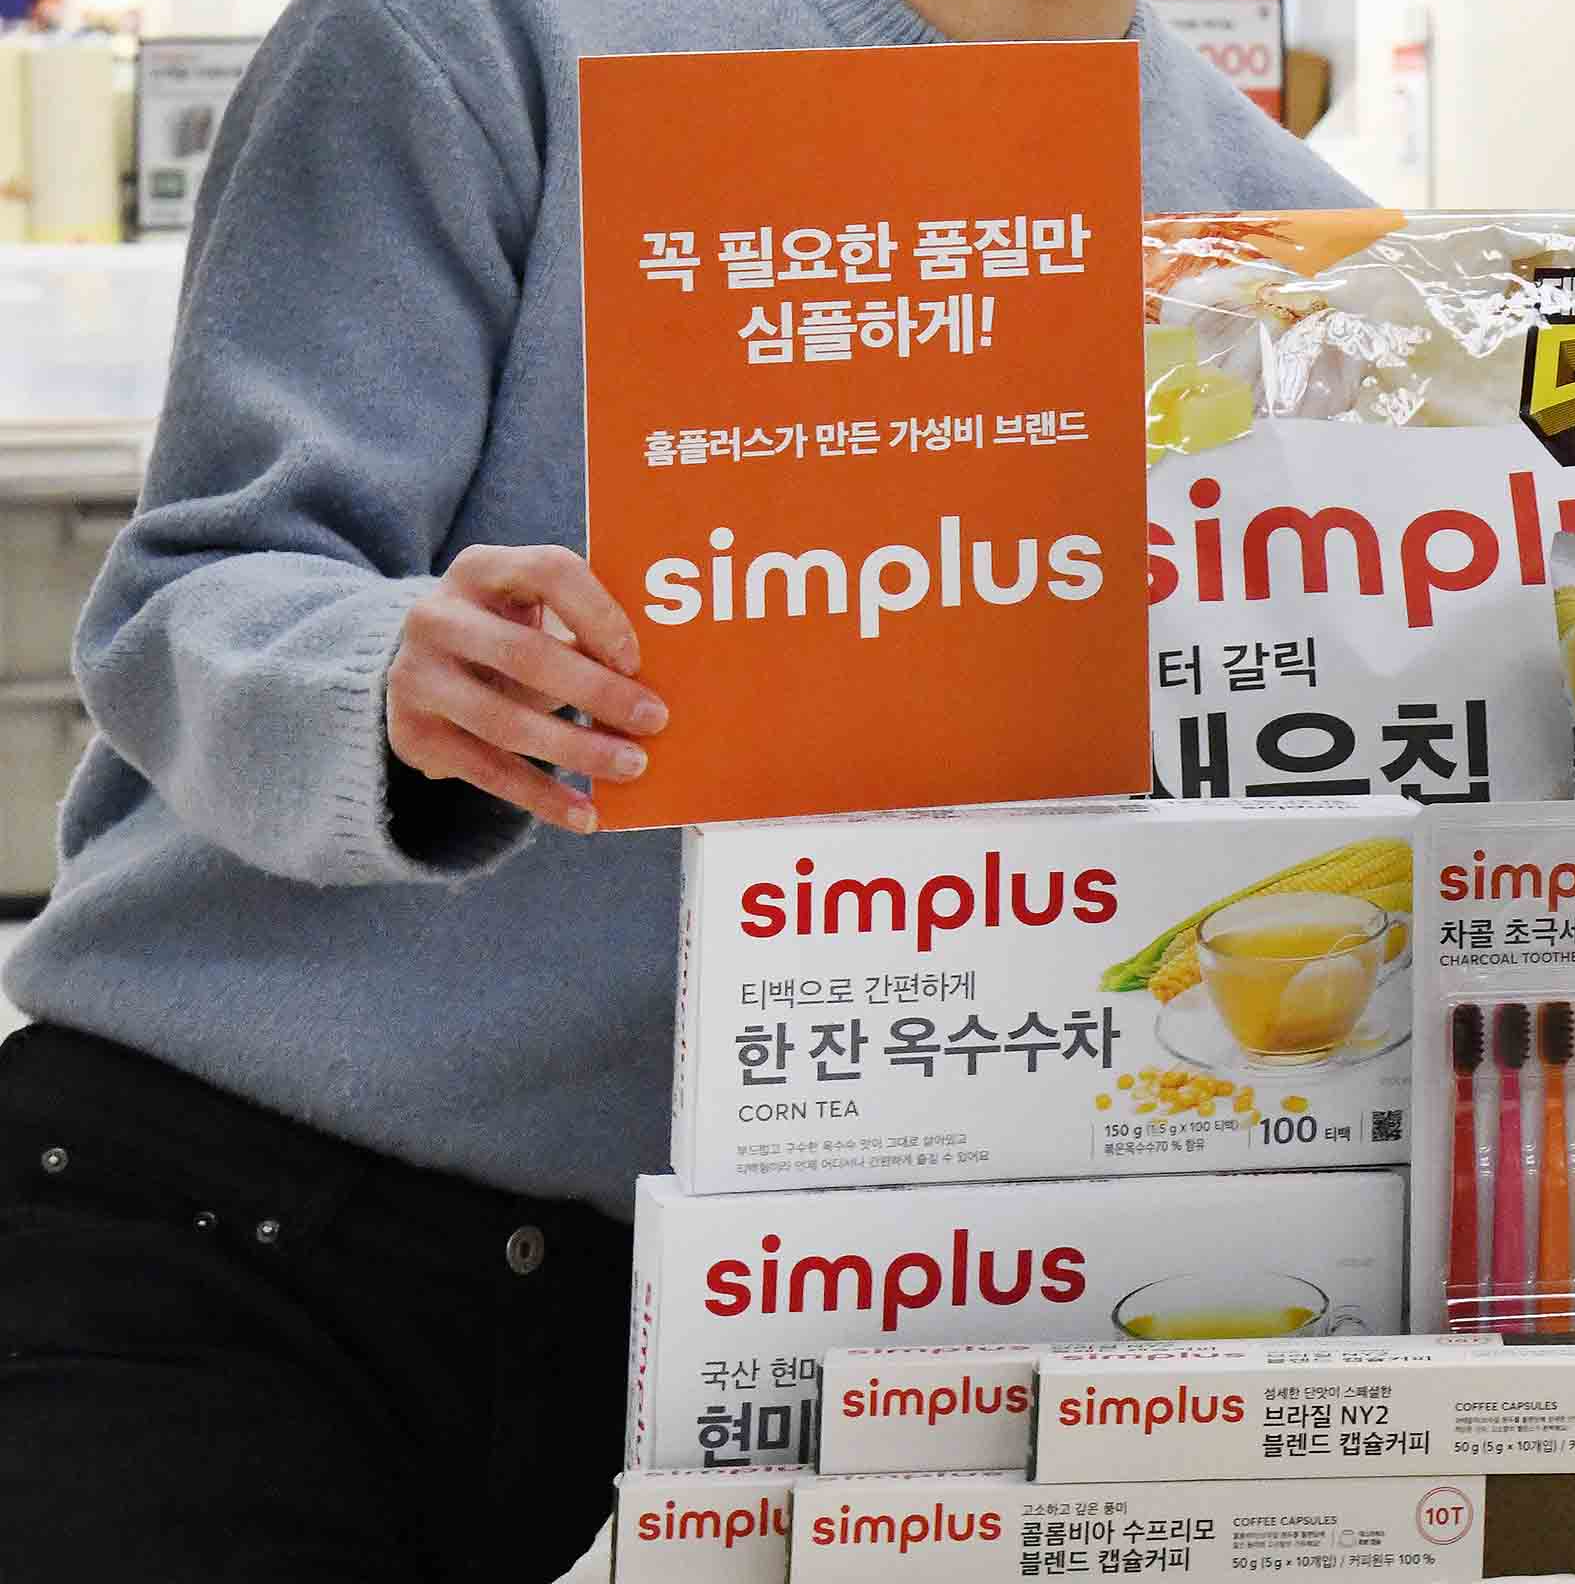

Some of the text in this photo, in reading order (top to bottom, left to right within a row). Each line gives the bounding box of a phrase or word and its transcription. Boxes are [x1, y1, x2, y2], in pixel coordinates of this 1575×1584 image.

[638, 213, 1092, 292] 꼭 필요한 품질만
[738, 296, 995, 365] 심플하게!
[644, 411, 1089, 467] 홈플러스가 만든 가성비 브랜드
[644, 515, 1104, 640] simplus
[1160, 637, 1318, 695] 터 갈릭
[741, 852, 1118, 952] simplus
[1440, 919, 1495, 949] 차콜
[1440, 952, 1517, 967] CHARCOAL
[741, 970, 977, 1011] 티백으로 간편하게
[736, 1006, 1121, 1086] 한 잔 옥수수차
[739, 1099, 860, 1123] CORN TEA
[1105, 1124, 1130, 1138] 150
[1260, 1115, 1351, 1145] 100 티백
[704, 1228, 1087, 1332] simplus
[701, 1359, 761, 1391] 국산
[842, 1375, 1033, 1425] simplus
[1059, 1385, 1246, 1434] simplus
[1455, 1400, 1558, 1412] COFFEE CAPSULES
[1263, 1404, 1390, 1430] 브라질 NY2
[1262, 1429, 1431, 1458] 블렌드 캡슐커피
[1023, 1504, 1070, 1516] 고소하고
[1233, 1515, 1337, 1527] COFFEE CAPSULES
[1425, 1506, 1464, 1525] 10T
[812, 1502, 1002, 1553] simplus
[1021, 1520, 1115, 1547] 콜롬비아
[1122, 1518, 1216, 1545] 수프리모
[1020, 1547, 1190, 1576] 블렌드 캡슐커피
